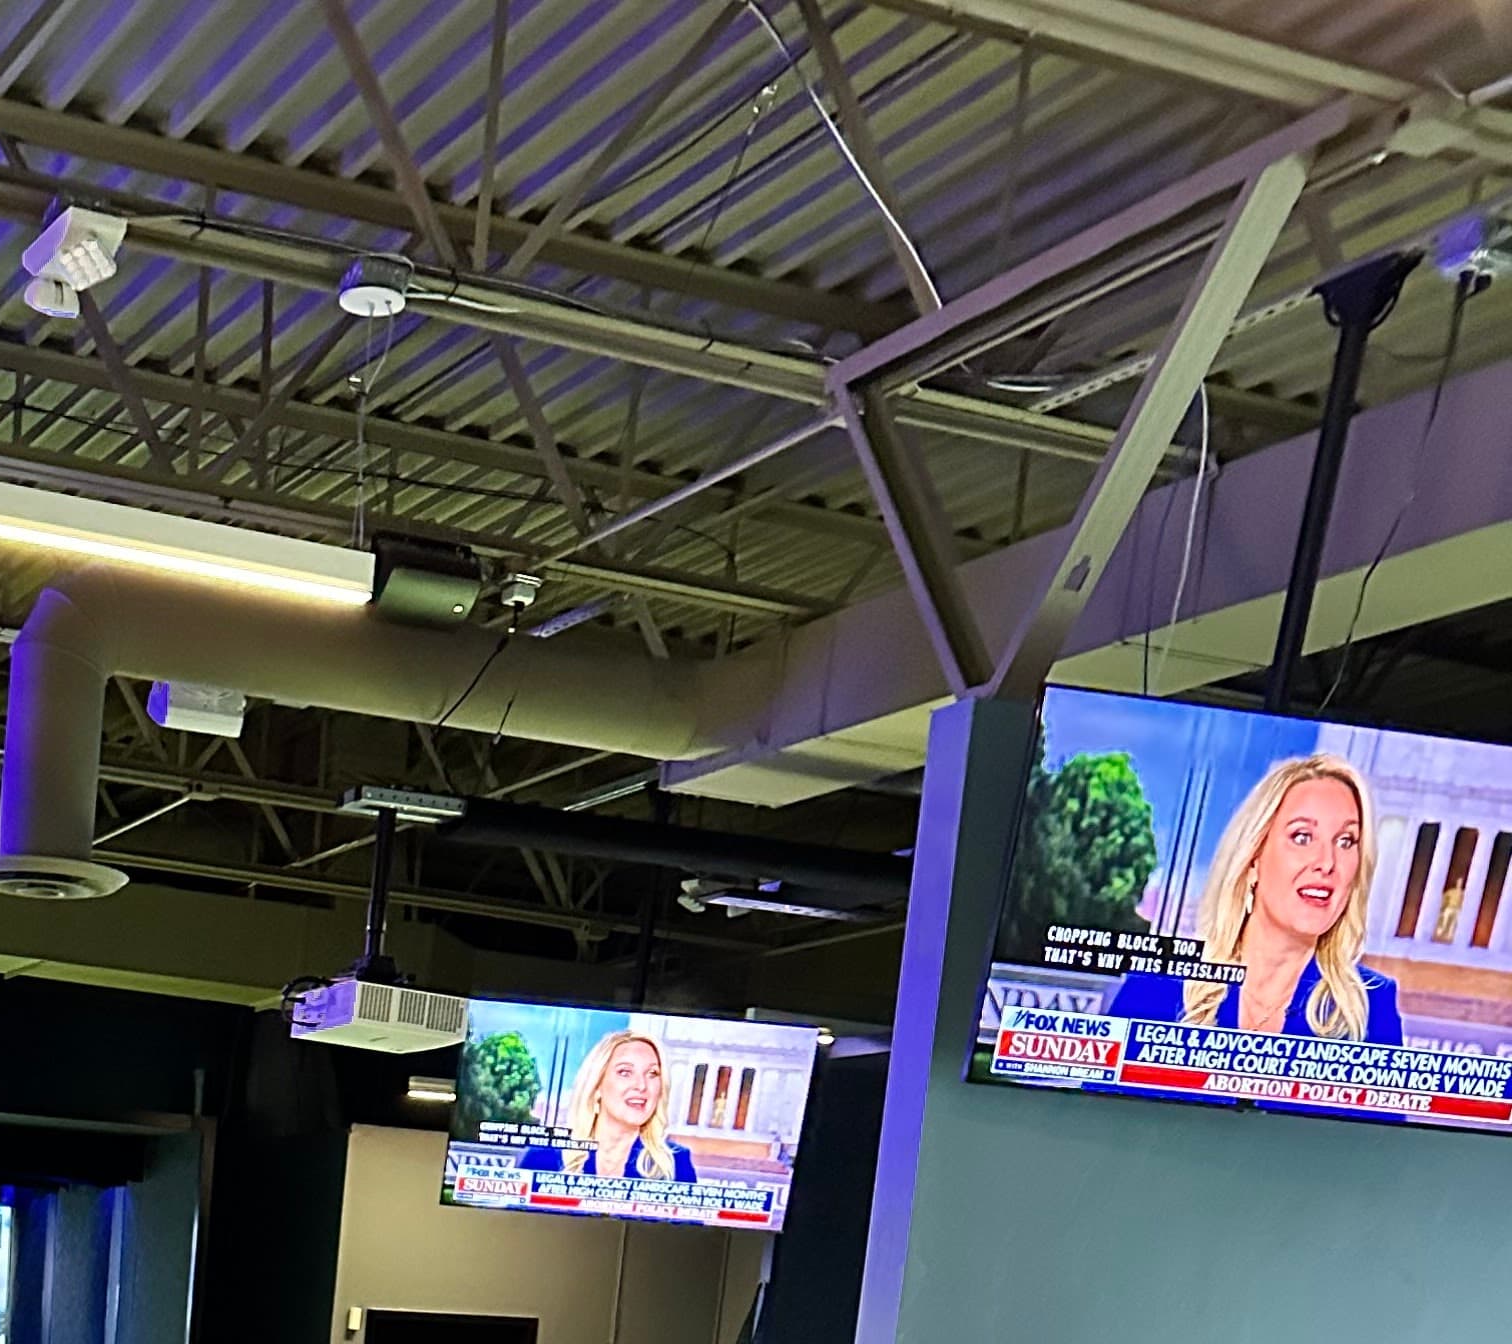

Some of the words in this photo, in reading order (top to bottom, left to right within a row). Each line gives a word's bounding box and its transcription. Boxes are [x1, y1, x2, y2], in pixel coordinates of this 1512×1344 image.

[1047, 925, 1111, 948] CHOPPING
[1117, 933, 1163, 955] BLOCK,
[1173, 939, 1202, 957] TOO.
[1044, 946, 1092, 966] THAT'S
[1097, 953, 1124, 970] WHY
[1130, 956, 1161, 974] THIS
[1023, 1013, 1060, 1032] FOX
[1061, 1017, 1112, 1038] NEWS
[1008, 1033, 1115, 1065] SUNDAY
[1135, 1023, 1186, 1045] LEGAL
[1187, 1029, 1201, 1044] &
[1203, 1031, 1297, 1057] ADVOCACY
[1296, 1041, 1390, 1067] LANDSCAPE
[1390, 1051, 1442, 1073] SEVEN
[1442, 1058, 1512, 1080] MONTHS
[1136, 1045, 1185, 1064] AFTER
[1187, 1051, 1230, 1069] HIGH
[1233, 1054, 1289, 1075] COURT
[1289, 1060, 1350, 1083] STRUCK
[1350, 1066, 1408, 1088] DOWN
[1408, 1073, 1440, 1092] ROE
[1443, 1076, 1458, 1092] V
[1458, 1078, 1507, 1098] WADE
[1202, 1074, 1294, 1097] ABORTION
[1297, 1082, 1366, 1103] POLICY
[1363, 1090, 1433, 1112] DEBATE
[463, 1178, 523, 1194] SUNDAY
[536, 1172, 567, 1185] LEGAL
[577, 1176, 633, 1190] ADVOCACY
